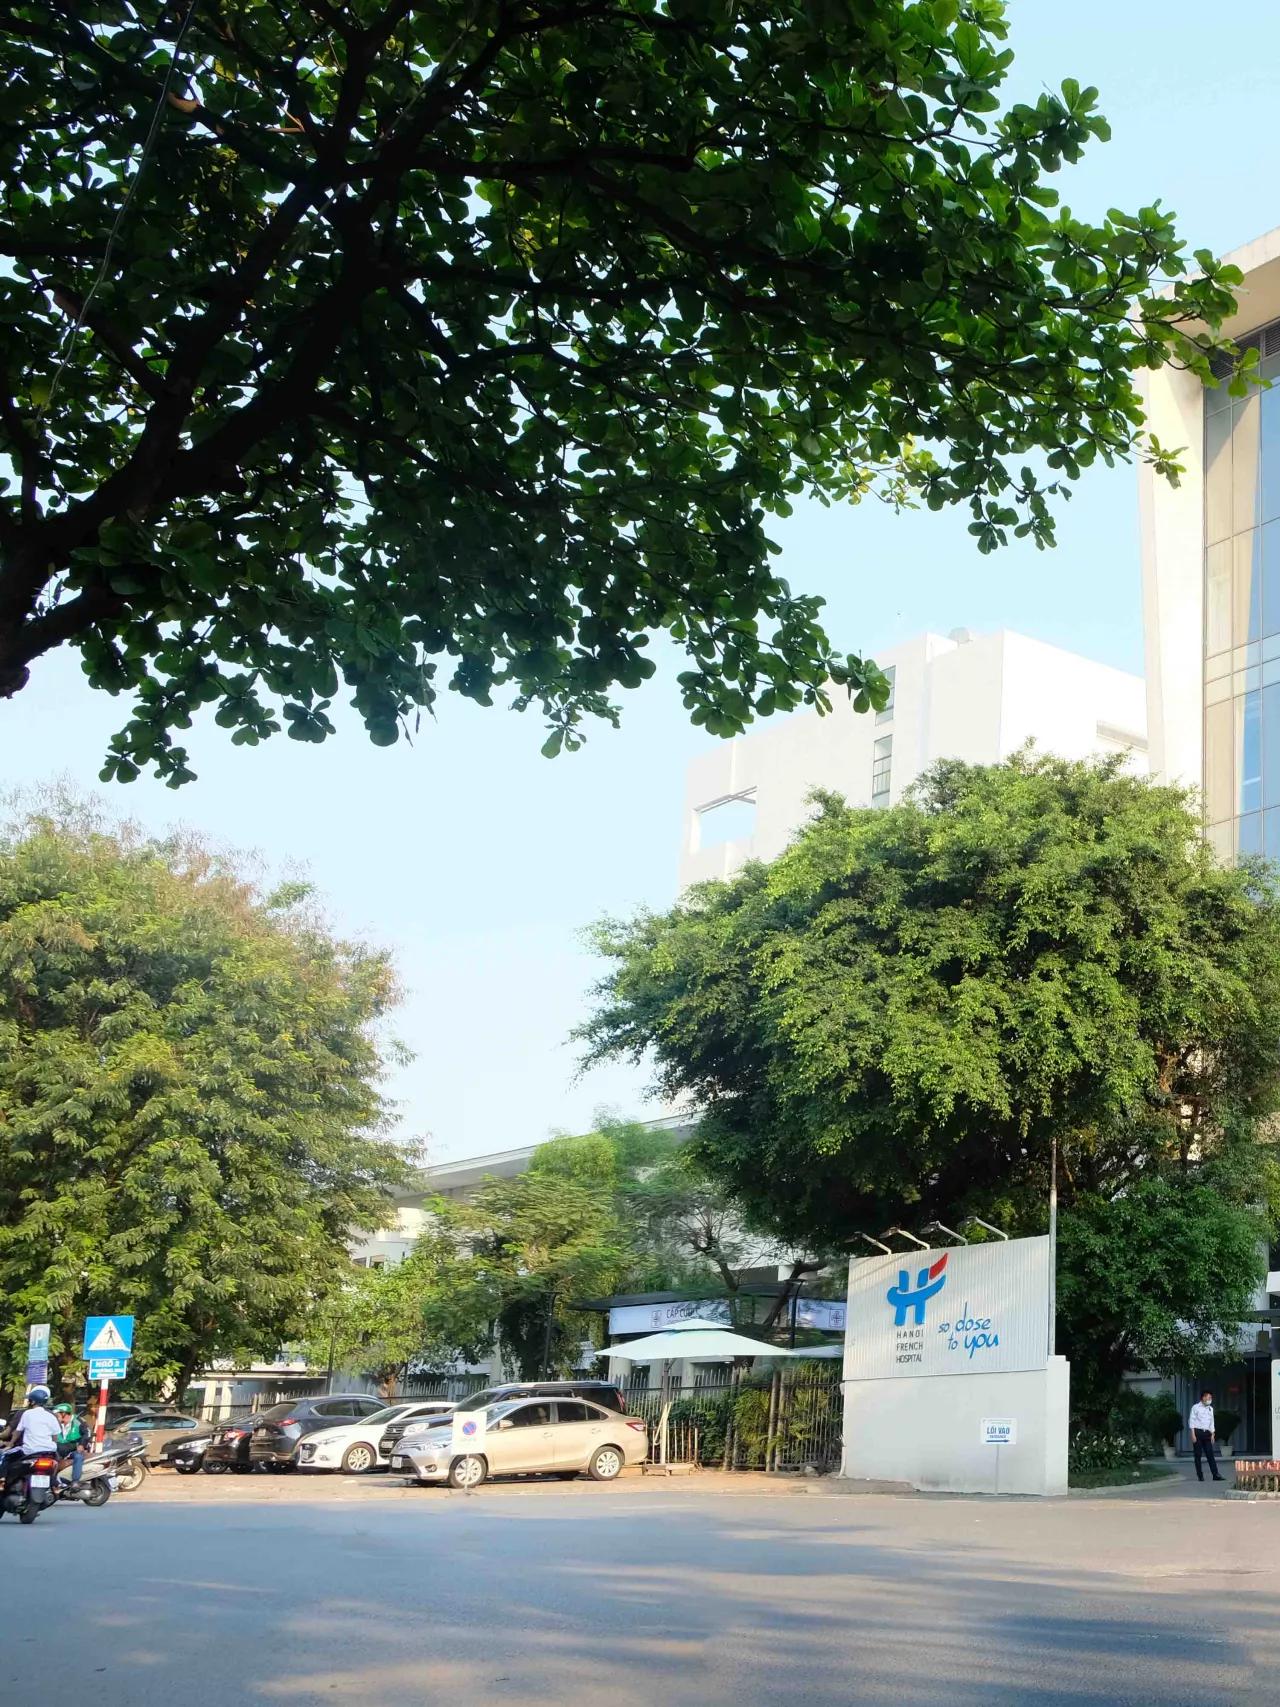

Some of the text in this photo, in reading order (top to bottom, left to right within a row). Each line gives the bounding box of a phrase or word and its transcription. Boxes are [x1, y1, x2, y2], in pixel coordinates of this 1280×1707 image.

[938, 1322, 950, 1333] so
[896, 1329, 924, 1338] HANOI
[896, 1342, 924, 1351] FRENCH
[947, 1331, 999, 1359] to you
[895, 1354, 922, 1364] HOSPITAL
